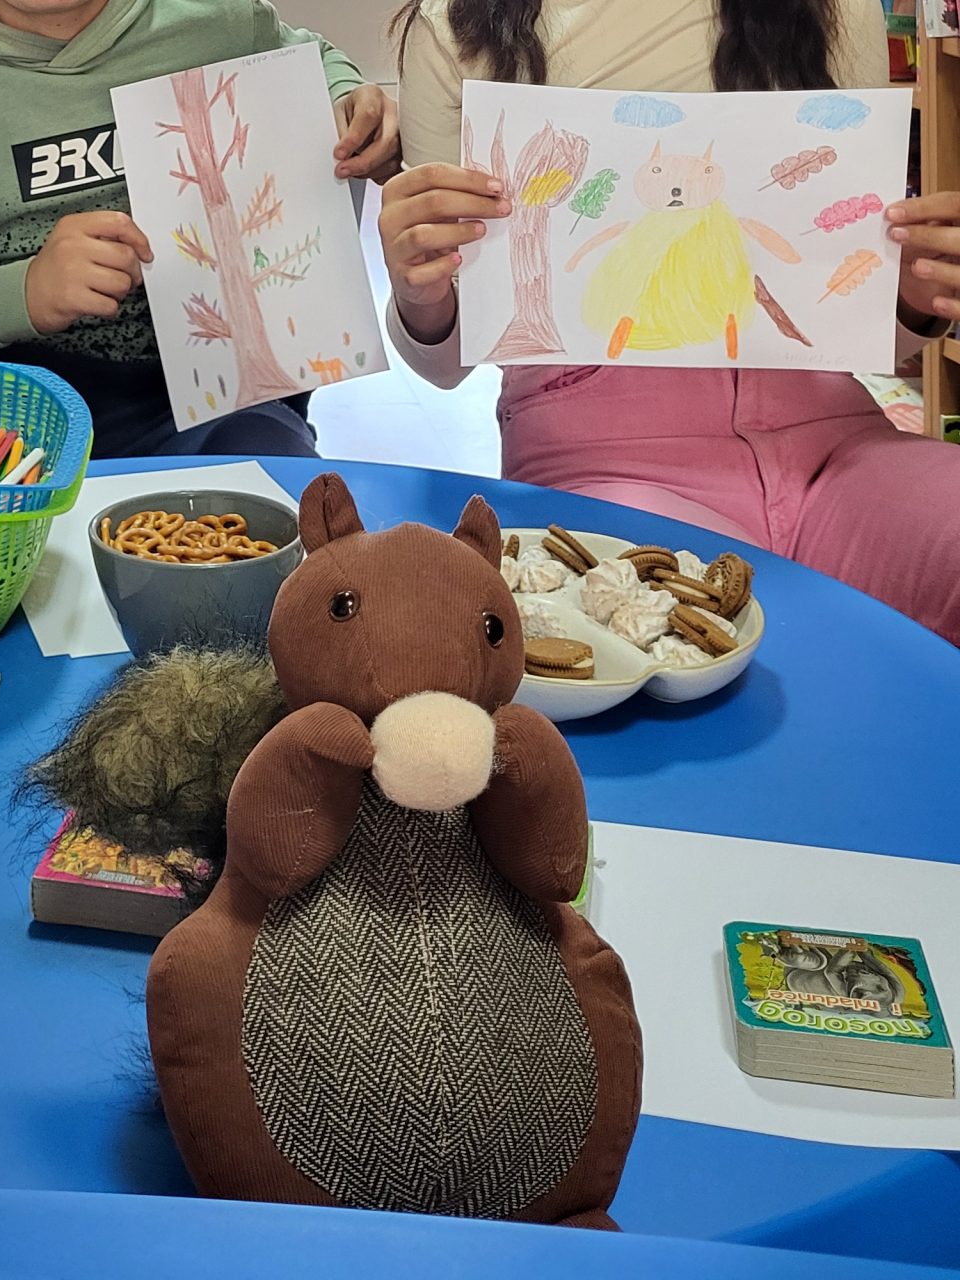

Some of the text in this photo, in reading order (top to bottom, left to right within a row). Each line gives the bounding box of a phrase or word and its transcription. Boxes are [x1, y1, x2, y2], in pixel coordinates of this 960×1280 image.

[756, 1000, 922, 1037] nosorog
[768, 989, 904, 1017] i mladunče
